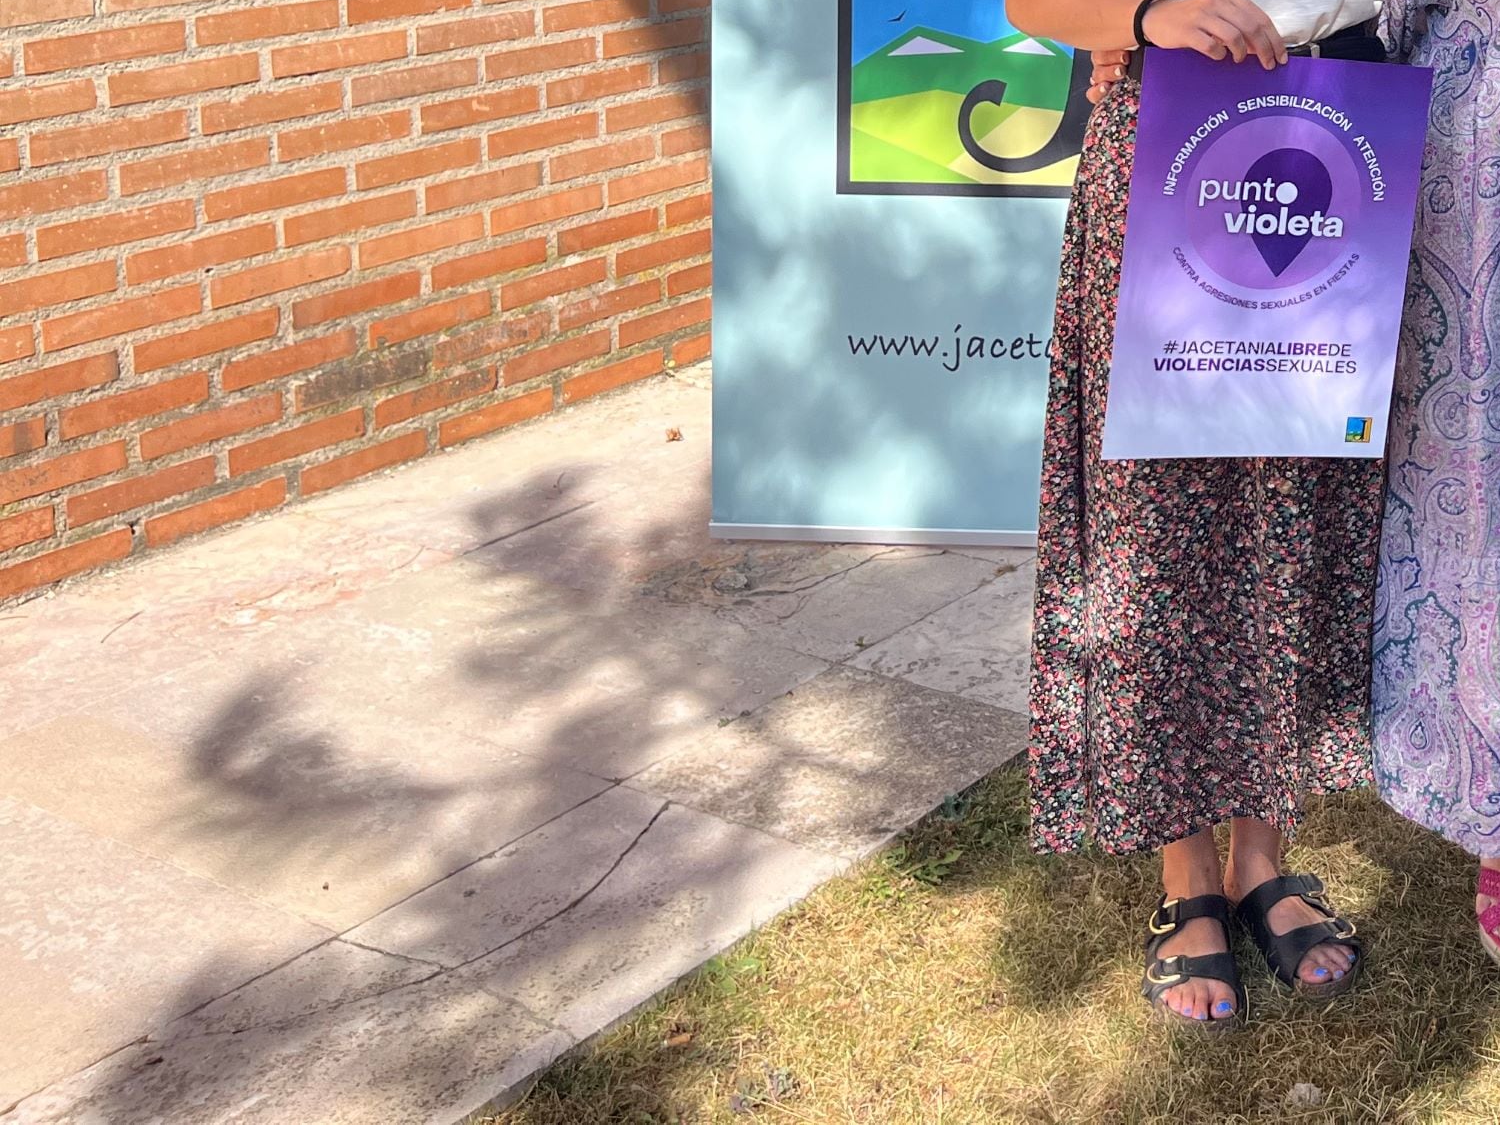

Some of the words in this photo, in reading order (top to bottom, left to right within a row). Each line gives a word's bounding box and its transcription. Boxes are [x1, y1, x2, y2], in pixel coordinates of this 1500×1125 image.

[1163, 109, 1230, 195] INFORMACIÓN
[1237, 95, 1353, 132] SENSIBILIZACIÓN
[1353, 135, 1385, 202] ATENCIÓN
[1198, 177, 1298, 206] punto
[1224, 205, 1344, 237] violeta
[1172, 246, 1199, 284] CONTRA
[1199, 281, 1258, 310] AGRESIONES
[1260, 293, 1312, 310] SEXUALES
[1312, 283, 1328, 298] EN
[1326, 252, 1361, 290] FIESTAS
[1163, 340, 1352, 357] #JACETANIALIBREDE
[1153, 357, 1357, 374] VIOLENCIASSEXUALES
